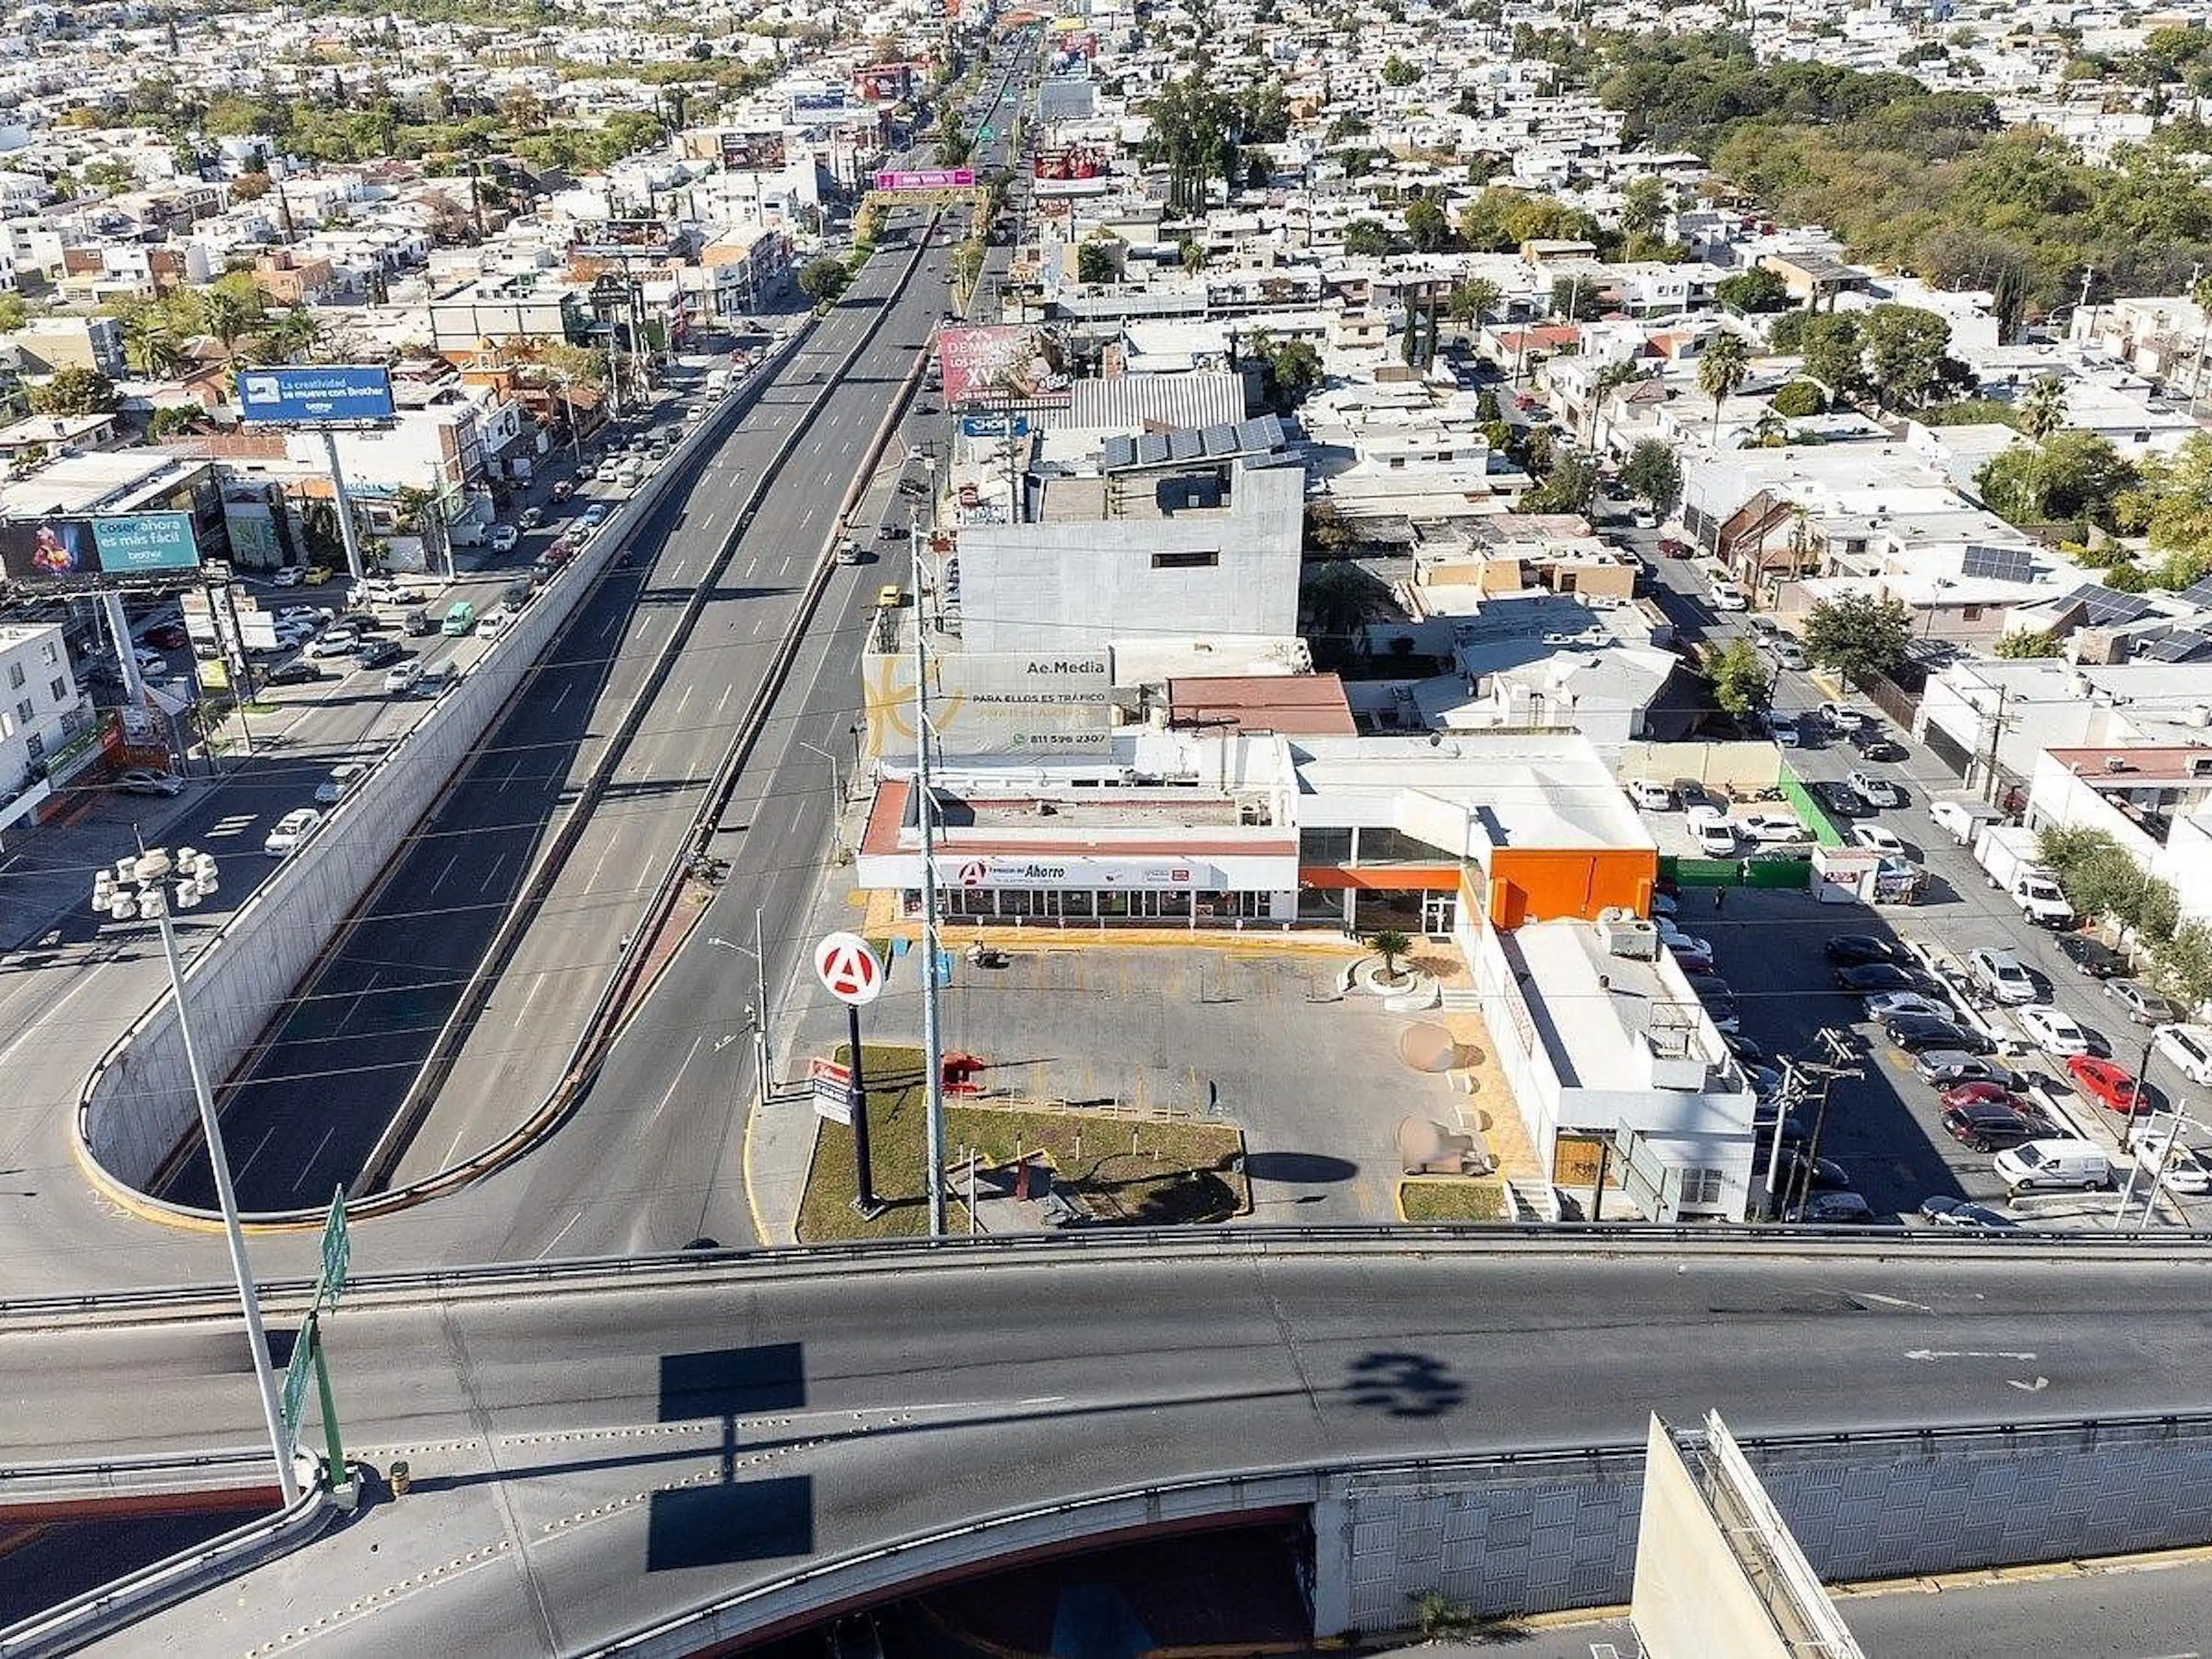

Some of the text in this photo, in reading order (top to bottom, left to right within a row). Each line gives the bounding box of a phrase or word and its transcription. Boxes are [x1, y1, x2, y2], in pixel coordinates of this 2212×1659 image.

[294, 378, 347, 389] creatividad
[966, 367, 994, 387] XV
[294, 389, 327, 400] mueve
[328, 389, 347, 397] con
[347, 387, 385, 397] Brother
[99, 519, 181, 533] Coser ahora
[101, 537, 118, 547] es
[1027, 661, 1105, 674] Ae.Media
[973, 694, 1002, 703] PARA
[1005, 695, 1038, 703] ELLOS
[1041, 695, 1055, 703] ES
[1024, 865, 1065, 878] Ahorro
